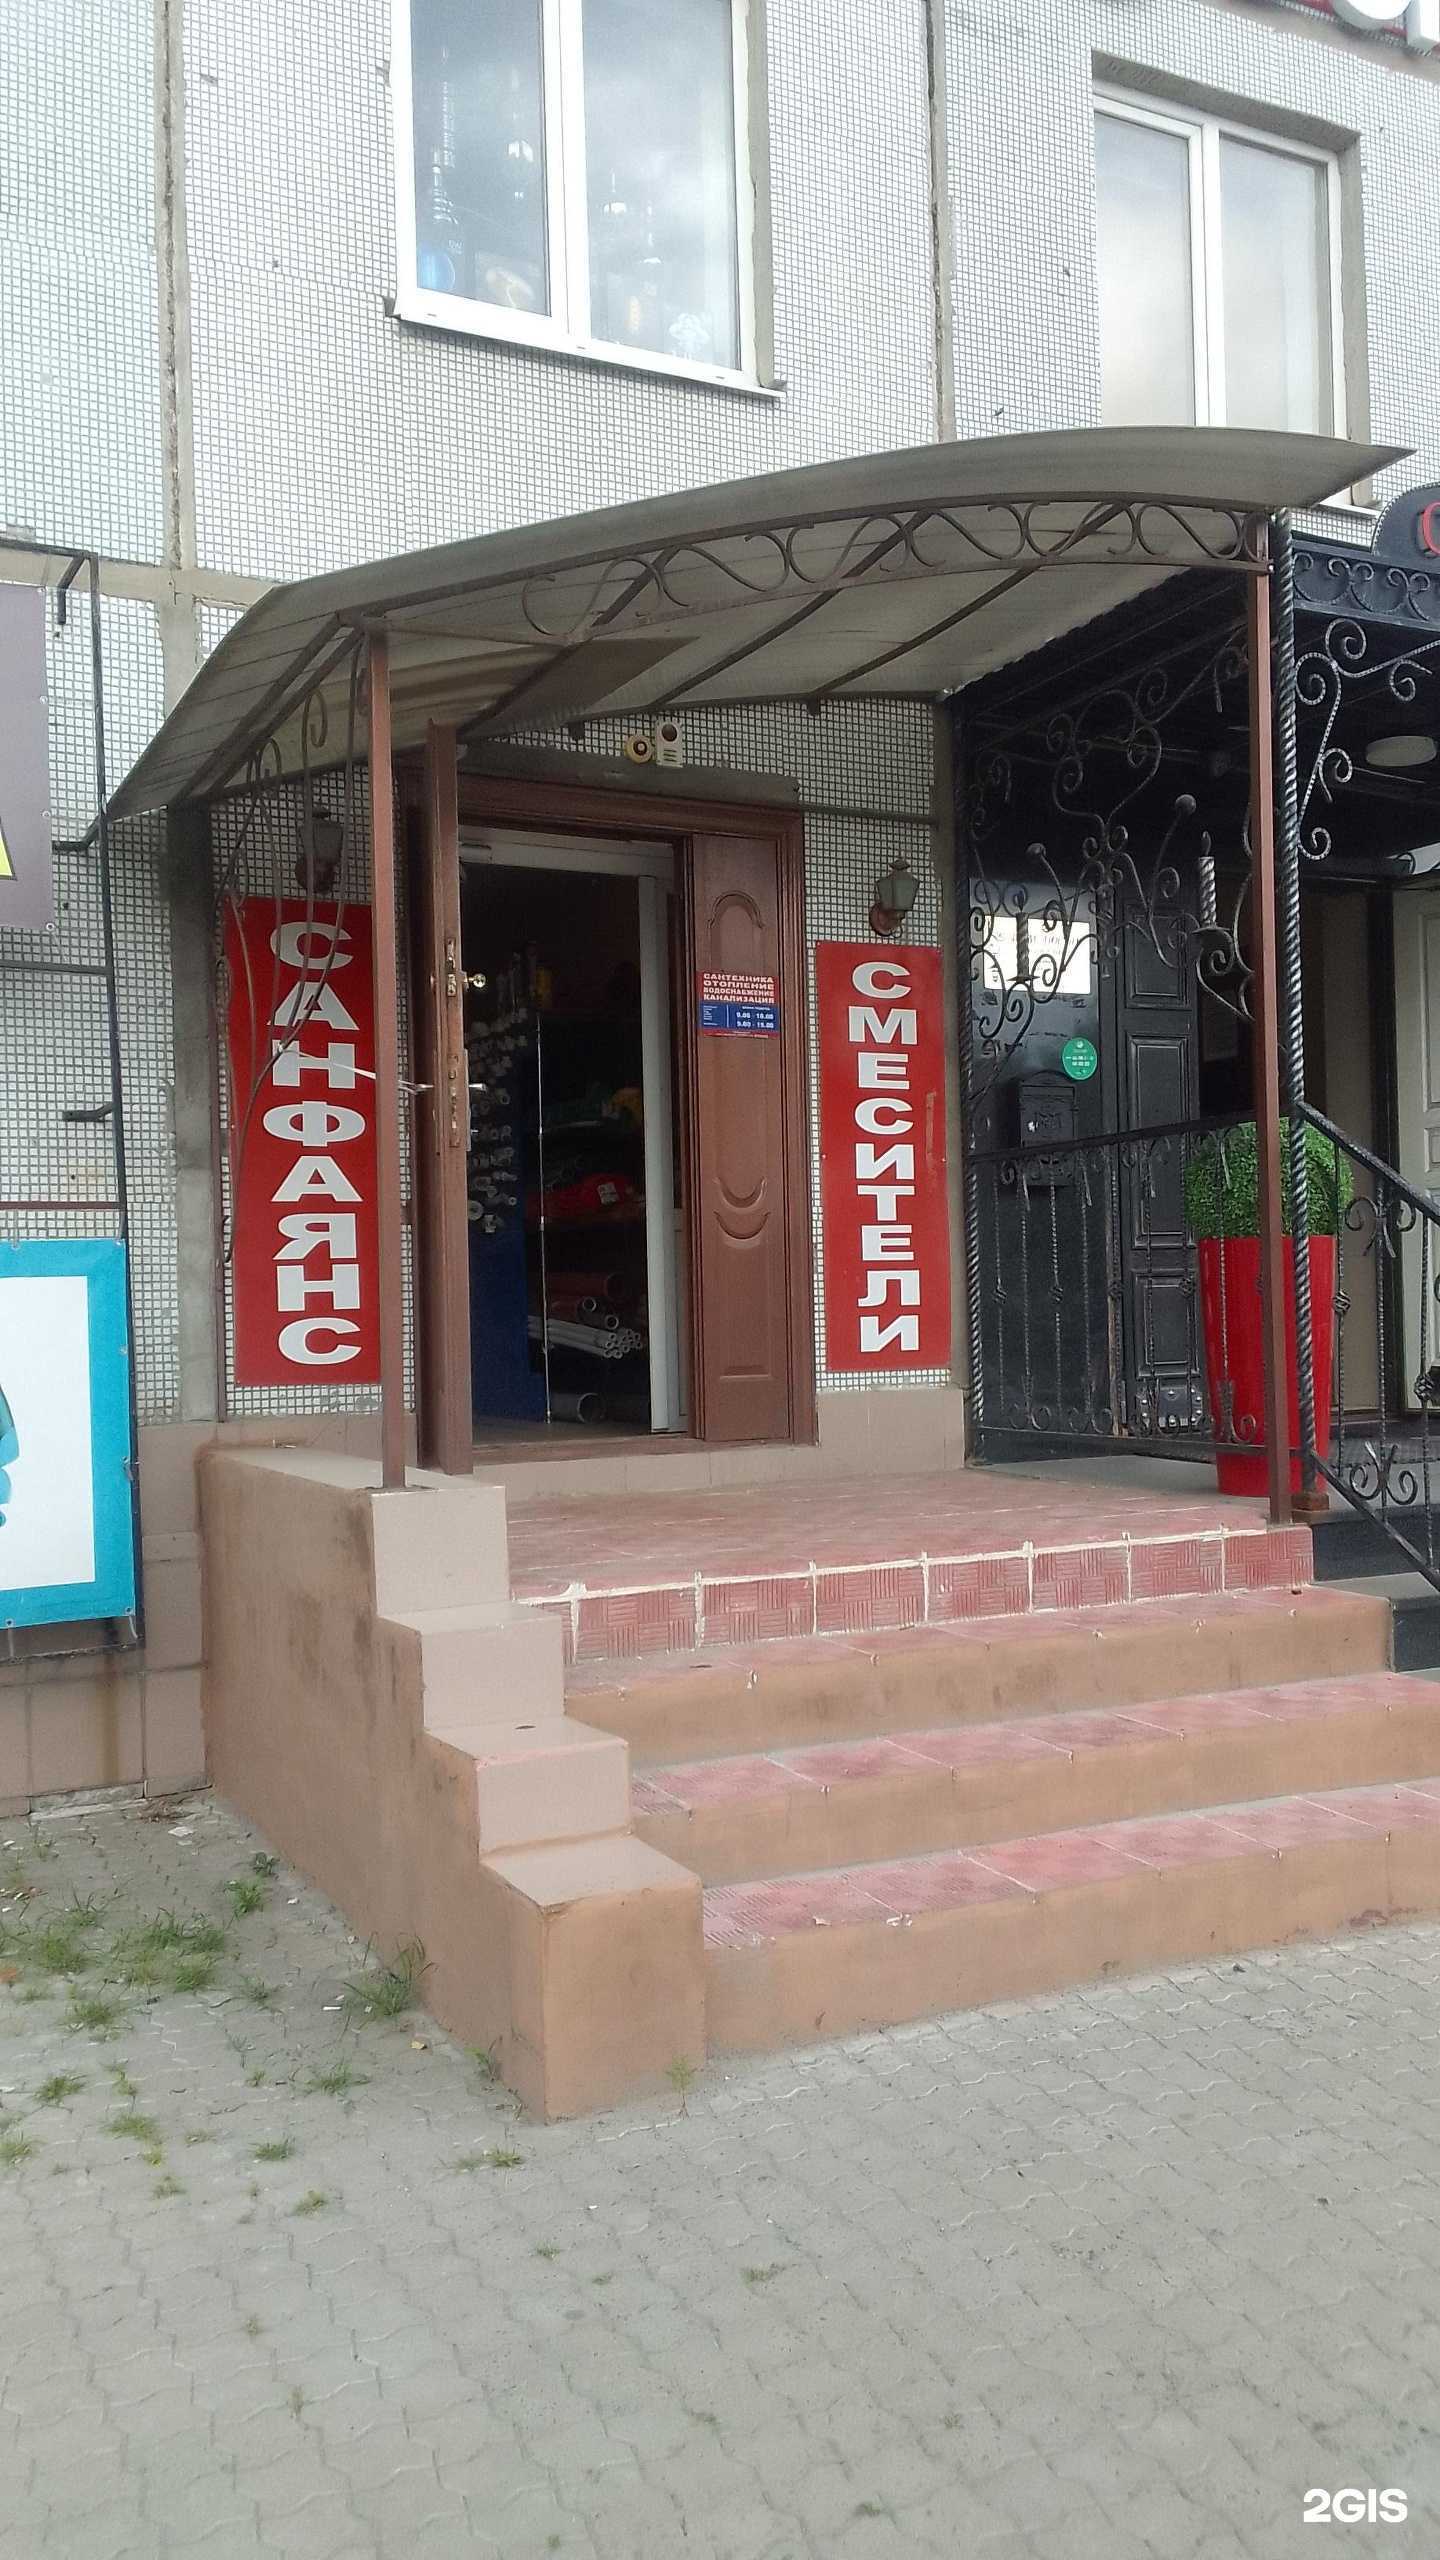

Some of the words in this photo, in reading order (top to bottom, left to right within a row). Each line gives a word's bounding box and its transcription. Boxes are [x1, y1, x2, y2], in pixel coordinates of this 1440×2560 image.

[703, 973, 774, 983] САНТЕХНИКА
[703, 980, 775, 990] ОТОПЛЕНИЕ
[703, 986, 775, 997] ВОДОСНАБЖЕНИЕ
[703, 993, 775, 1004] КАНАЛИЗАЦИЯ
[263, 921, 366, 1366] САНФАЯНС
[848, 961, 921, 1353] СМЕСИТЕЛИ
